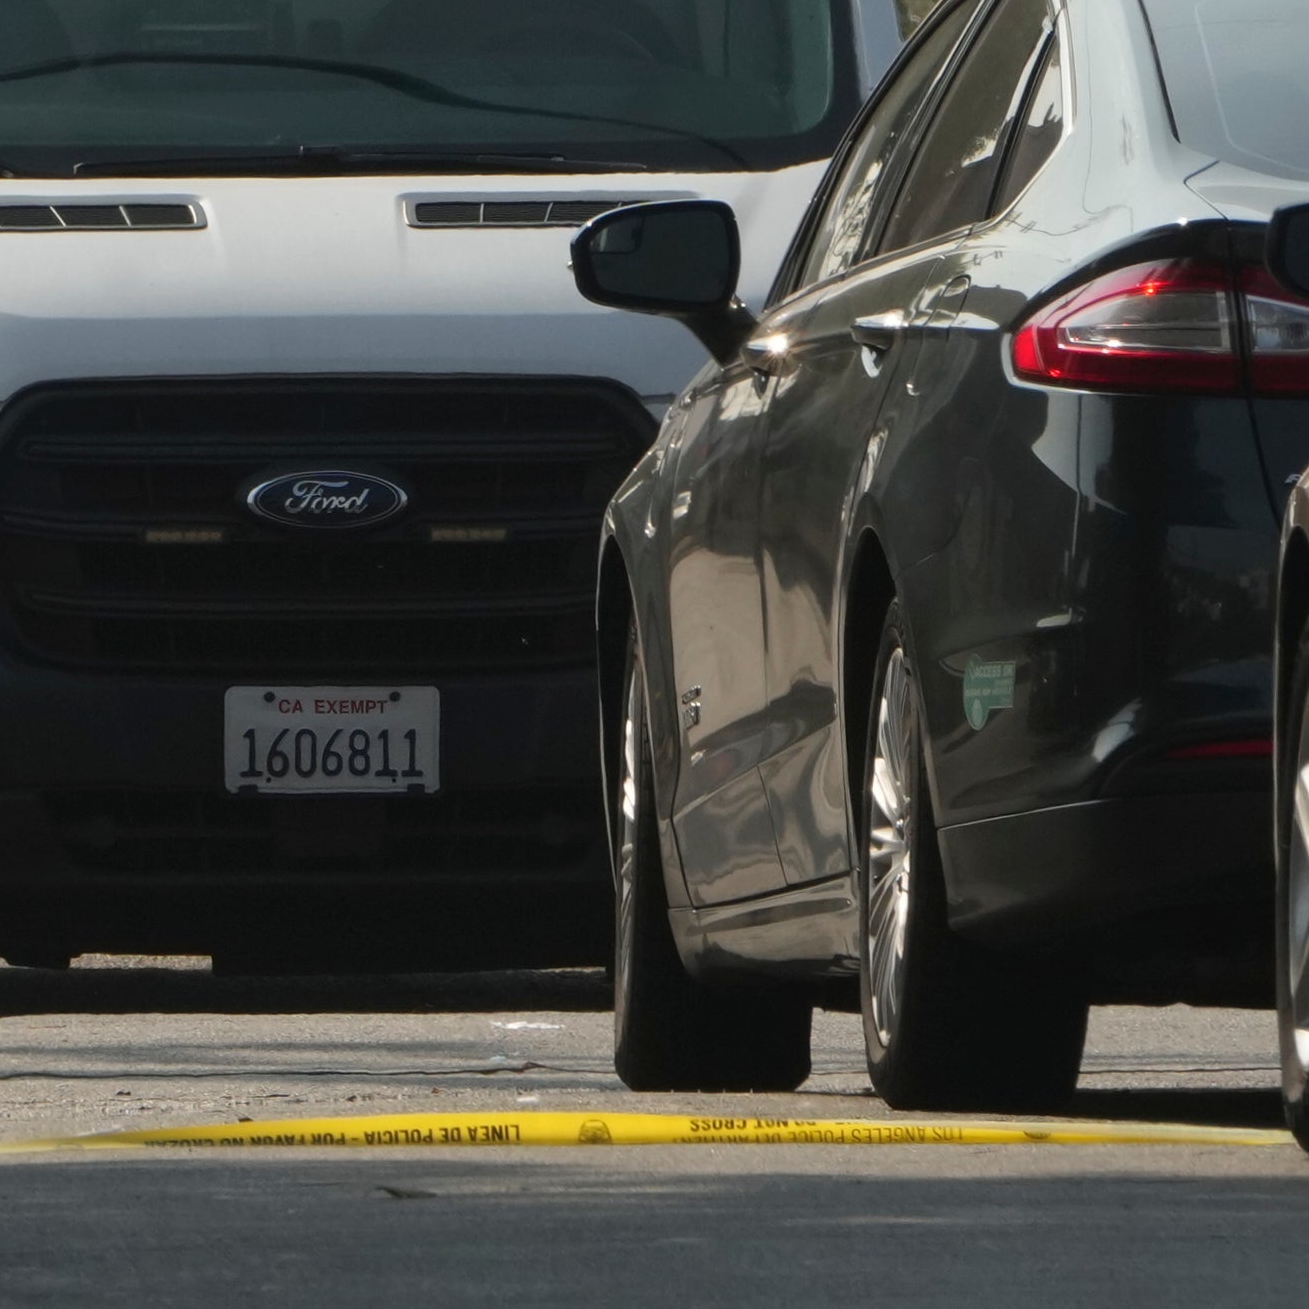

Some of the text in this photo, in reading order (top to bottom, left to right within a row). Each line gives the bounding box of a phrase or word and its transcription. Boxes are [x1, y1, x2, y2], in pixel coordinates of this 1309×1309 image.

[284, 480, 370, 514] Ford
[278, 699, 389, 715] CA EXEMPT
[239, 728, 424, 778] 1606811
[364, 1129, 434, 1145] POLICIA
[439, 1127, 462, 1143] DE
[467, 1124, 521, 1142] LINEA
